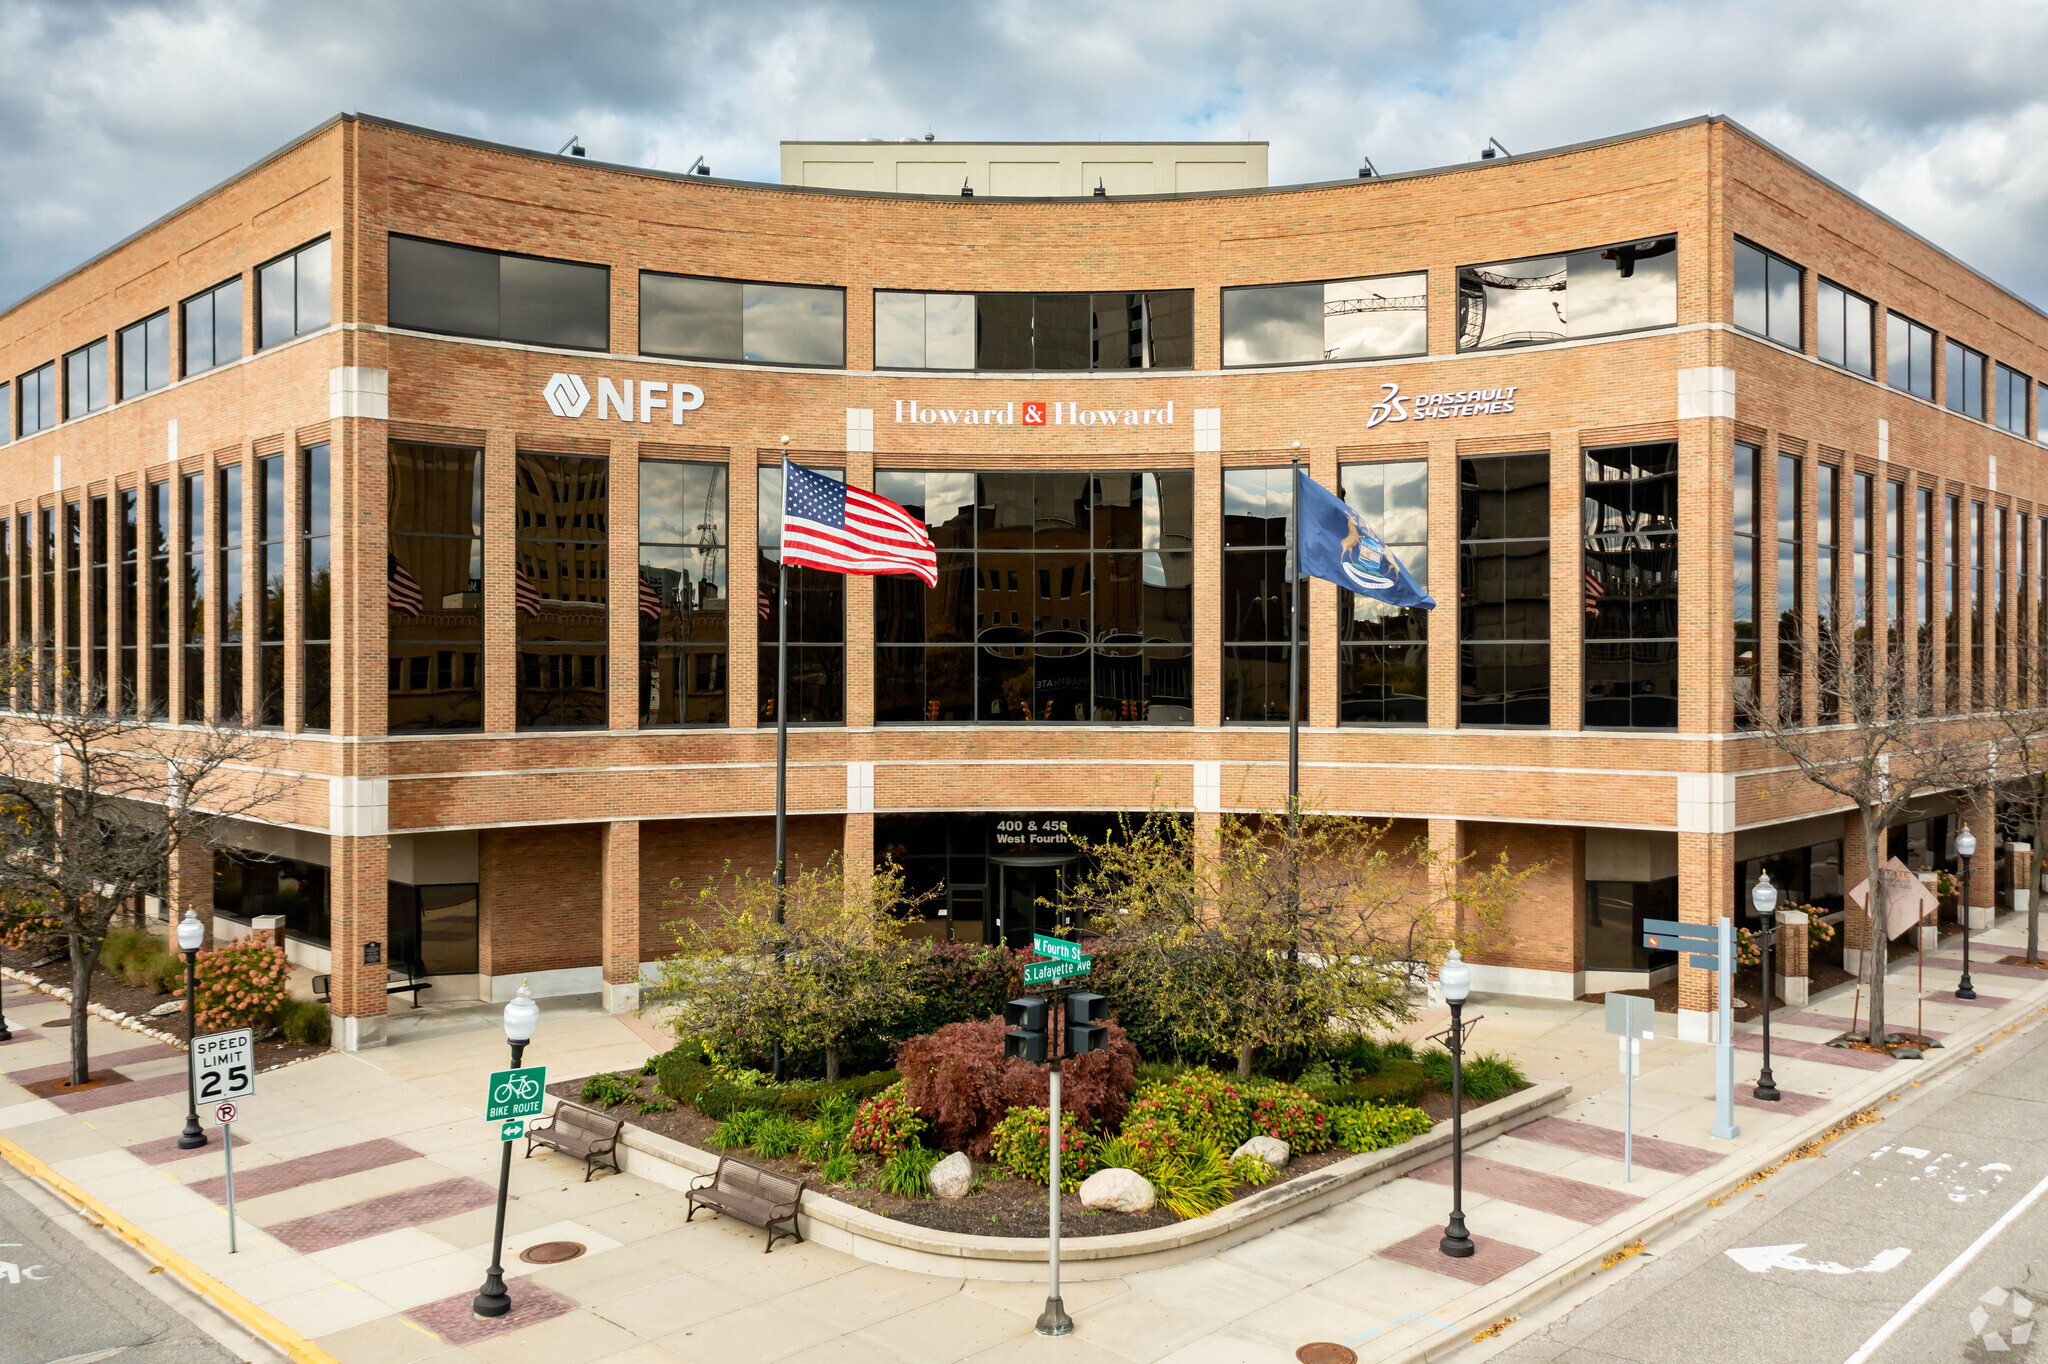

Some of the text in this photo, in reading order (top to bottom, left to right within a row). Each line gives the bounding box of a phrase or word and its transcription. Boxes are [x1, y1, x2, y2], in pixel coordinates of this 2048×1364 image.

[598, 377, 705, 425] NFP
[1415, 386, 1519, 407] DASSAULT
[893, 400, 1174, 425] Howard & Howard
[1412, 400, 1515, 421] SYSTEMES
[997, 820, 1068, 832] 400 & 450
[997, 834, 1068, 844] West Fourth
[1043, 940, 1069, 957] Fourth
[1072, 947, 1081, 960] St
[1024, 960, 1090, 982] S. Lafayette Ave
[198, 1036, 247, 1054] SPEED
[203, 1051, 242, 1068] LIMIT
[200, 1065, 249, 1098] 25
[490, 1101, 539, 1117] BIKE ROUTE
